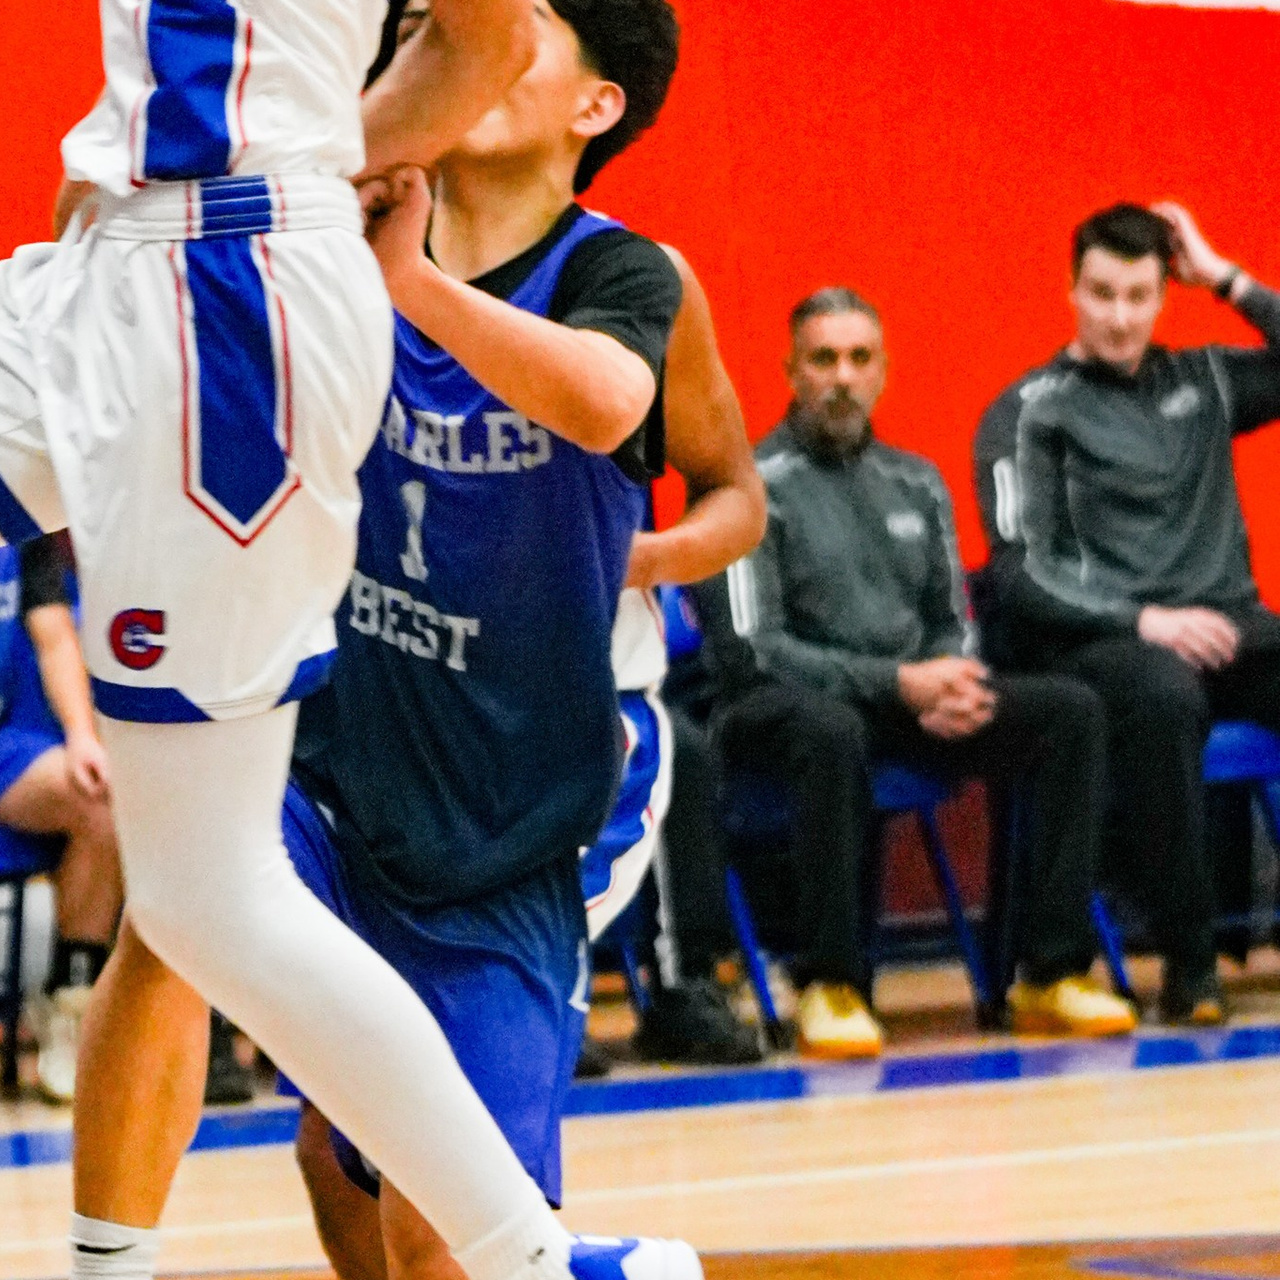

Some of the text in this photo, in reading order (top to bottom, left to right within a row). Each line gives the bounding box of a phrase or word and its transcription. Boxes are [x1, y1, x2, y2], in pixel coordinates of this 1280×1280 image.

[381, 394, 552, 474] ARLES
[399, 480, 429, 583] 1
[349, 570, 480, 671] BEST
